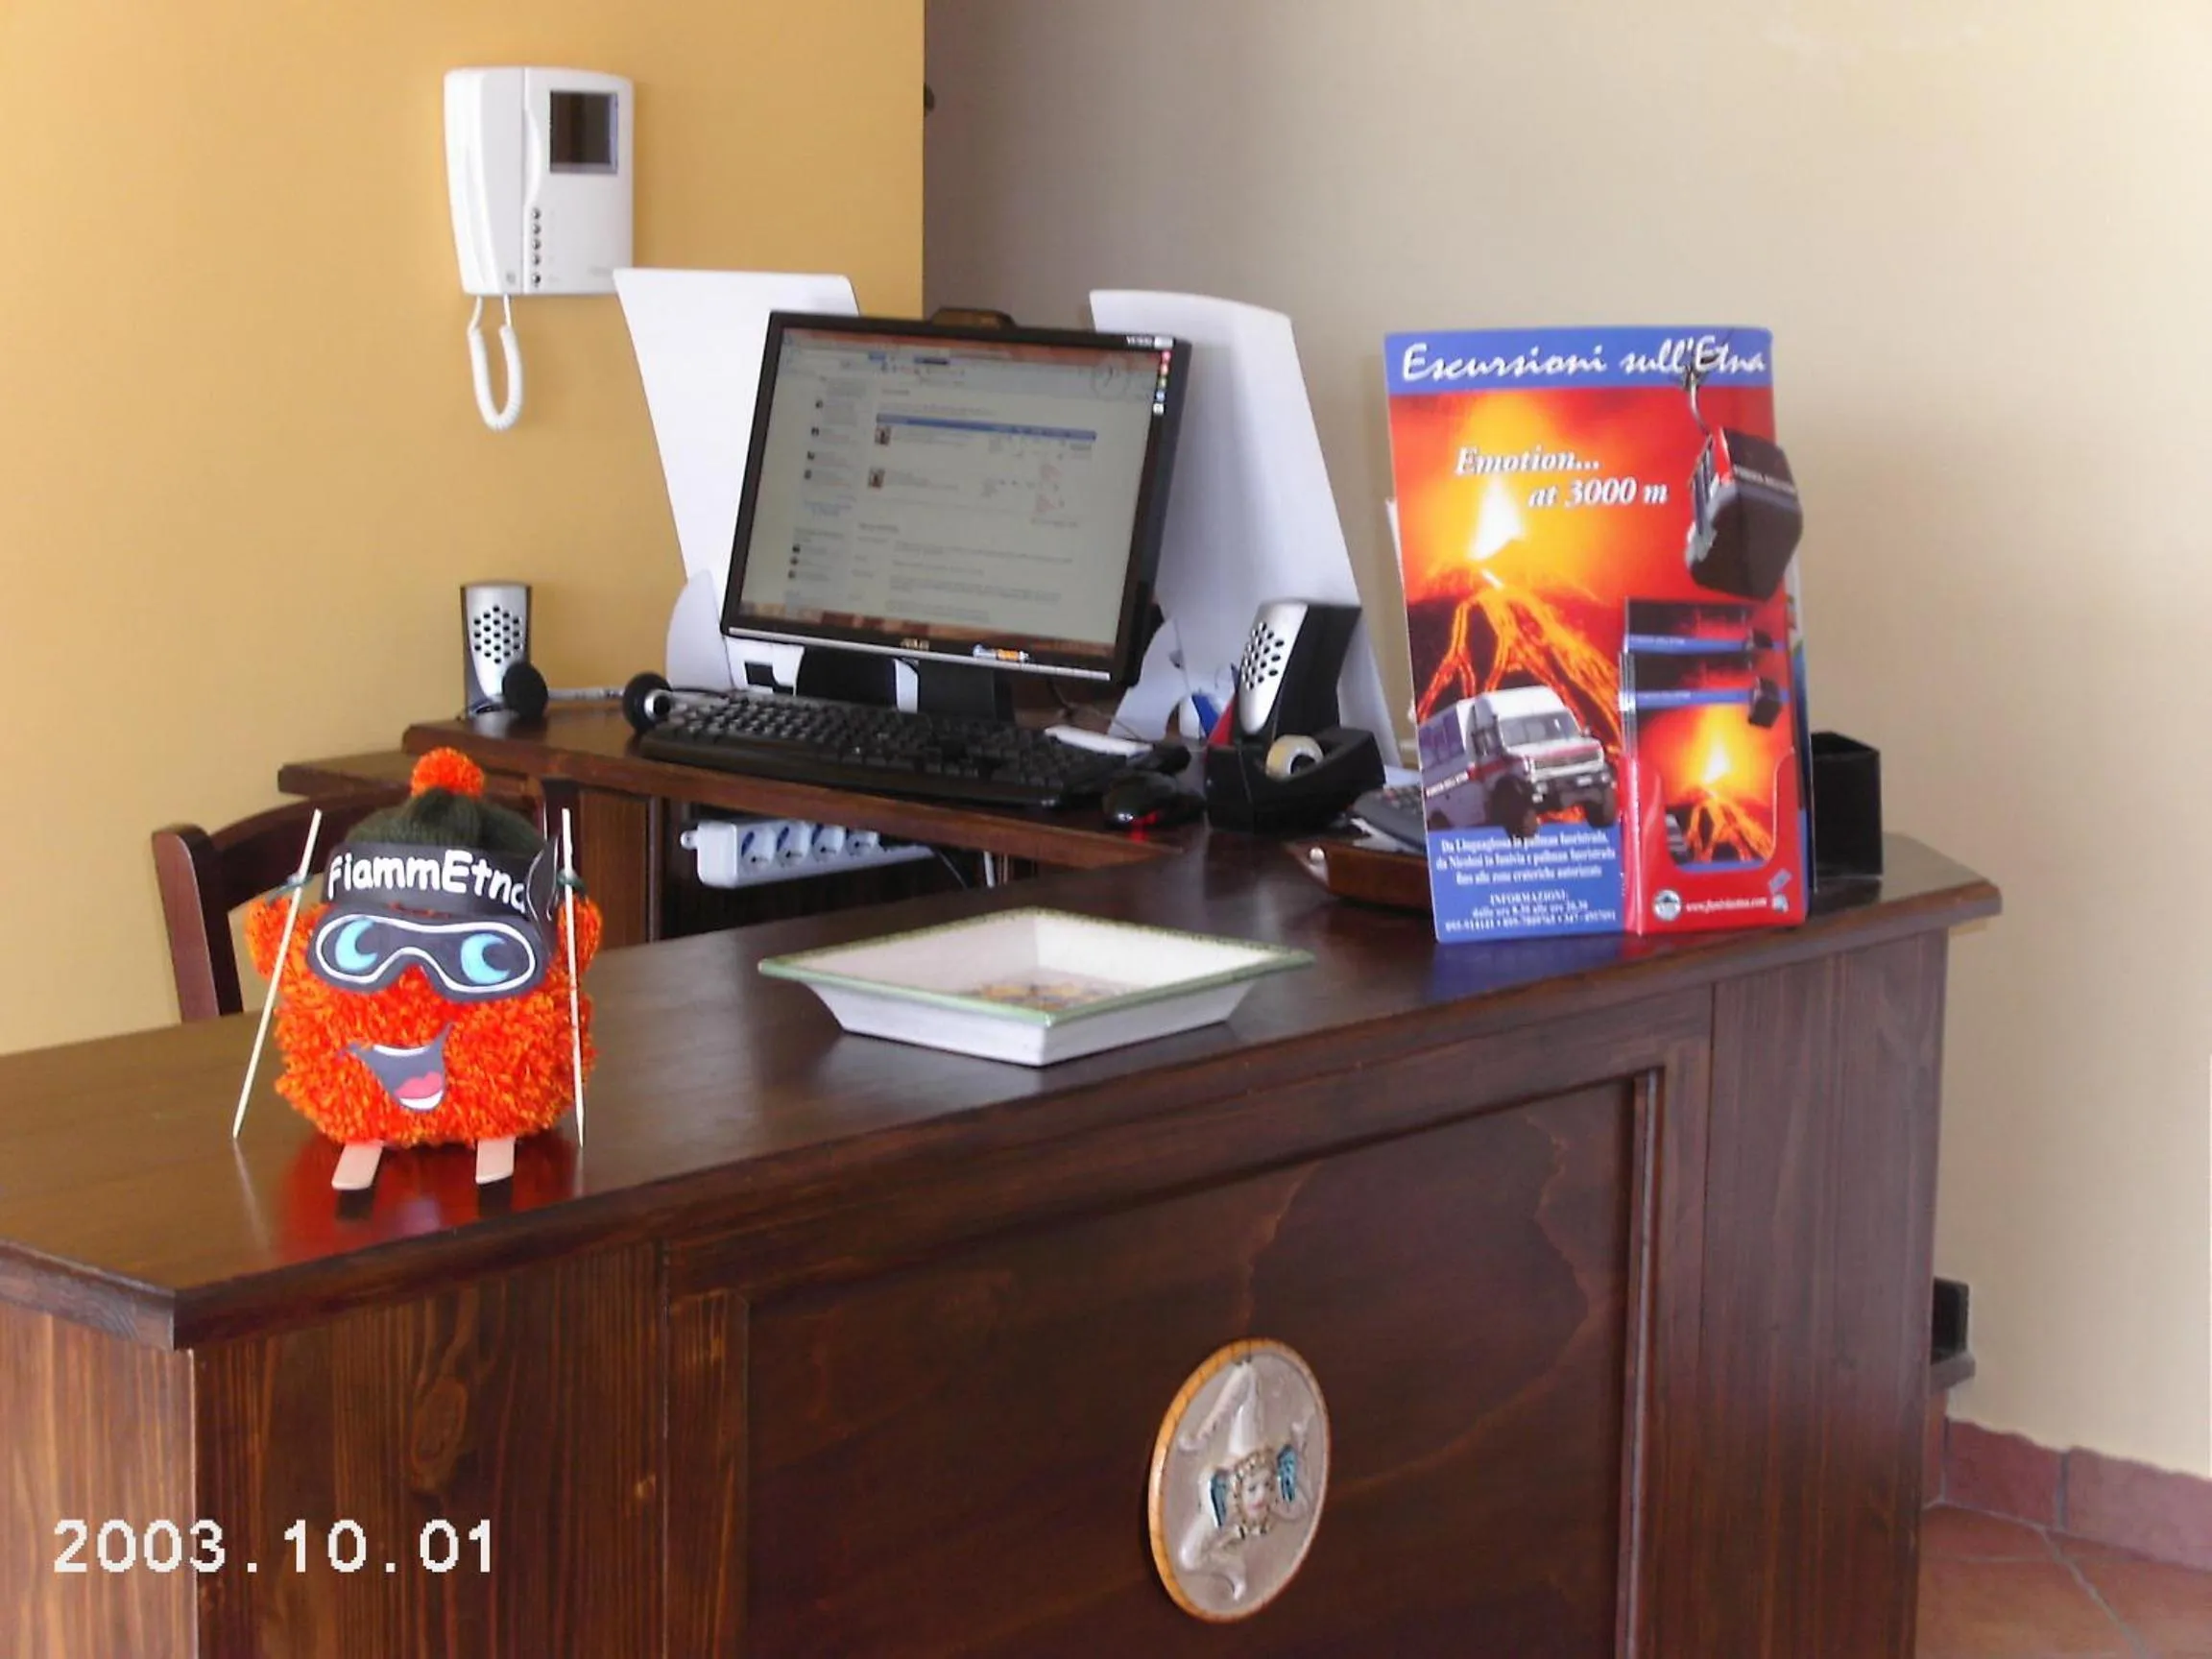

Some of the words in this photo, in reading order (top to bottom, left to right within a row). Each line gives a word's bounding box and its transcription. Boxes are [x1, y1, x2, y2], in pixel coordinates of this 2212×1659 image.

[1402, 342, 1609, 382] Escursioni
[1619, 333, 1767, 373] sull'Etna
[1454, 445, 1600, 477] Emotion...
[1528, 480, 1558, 507] at
[1565, 477, 1638, 507] 3000
[1644, 483, 1669, 504] m
